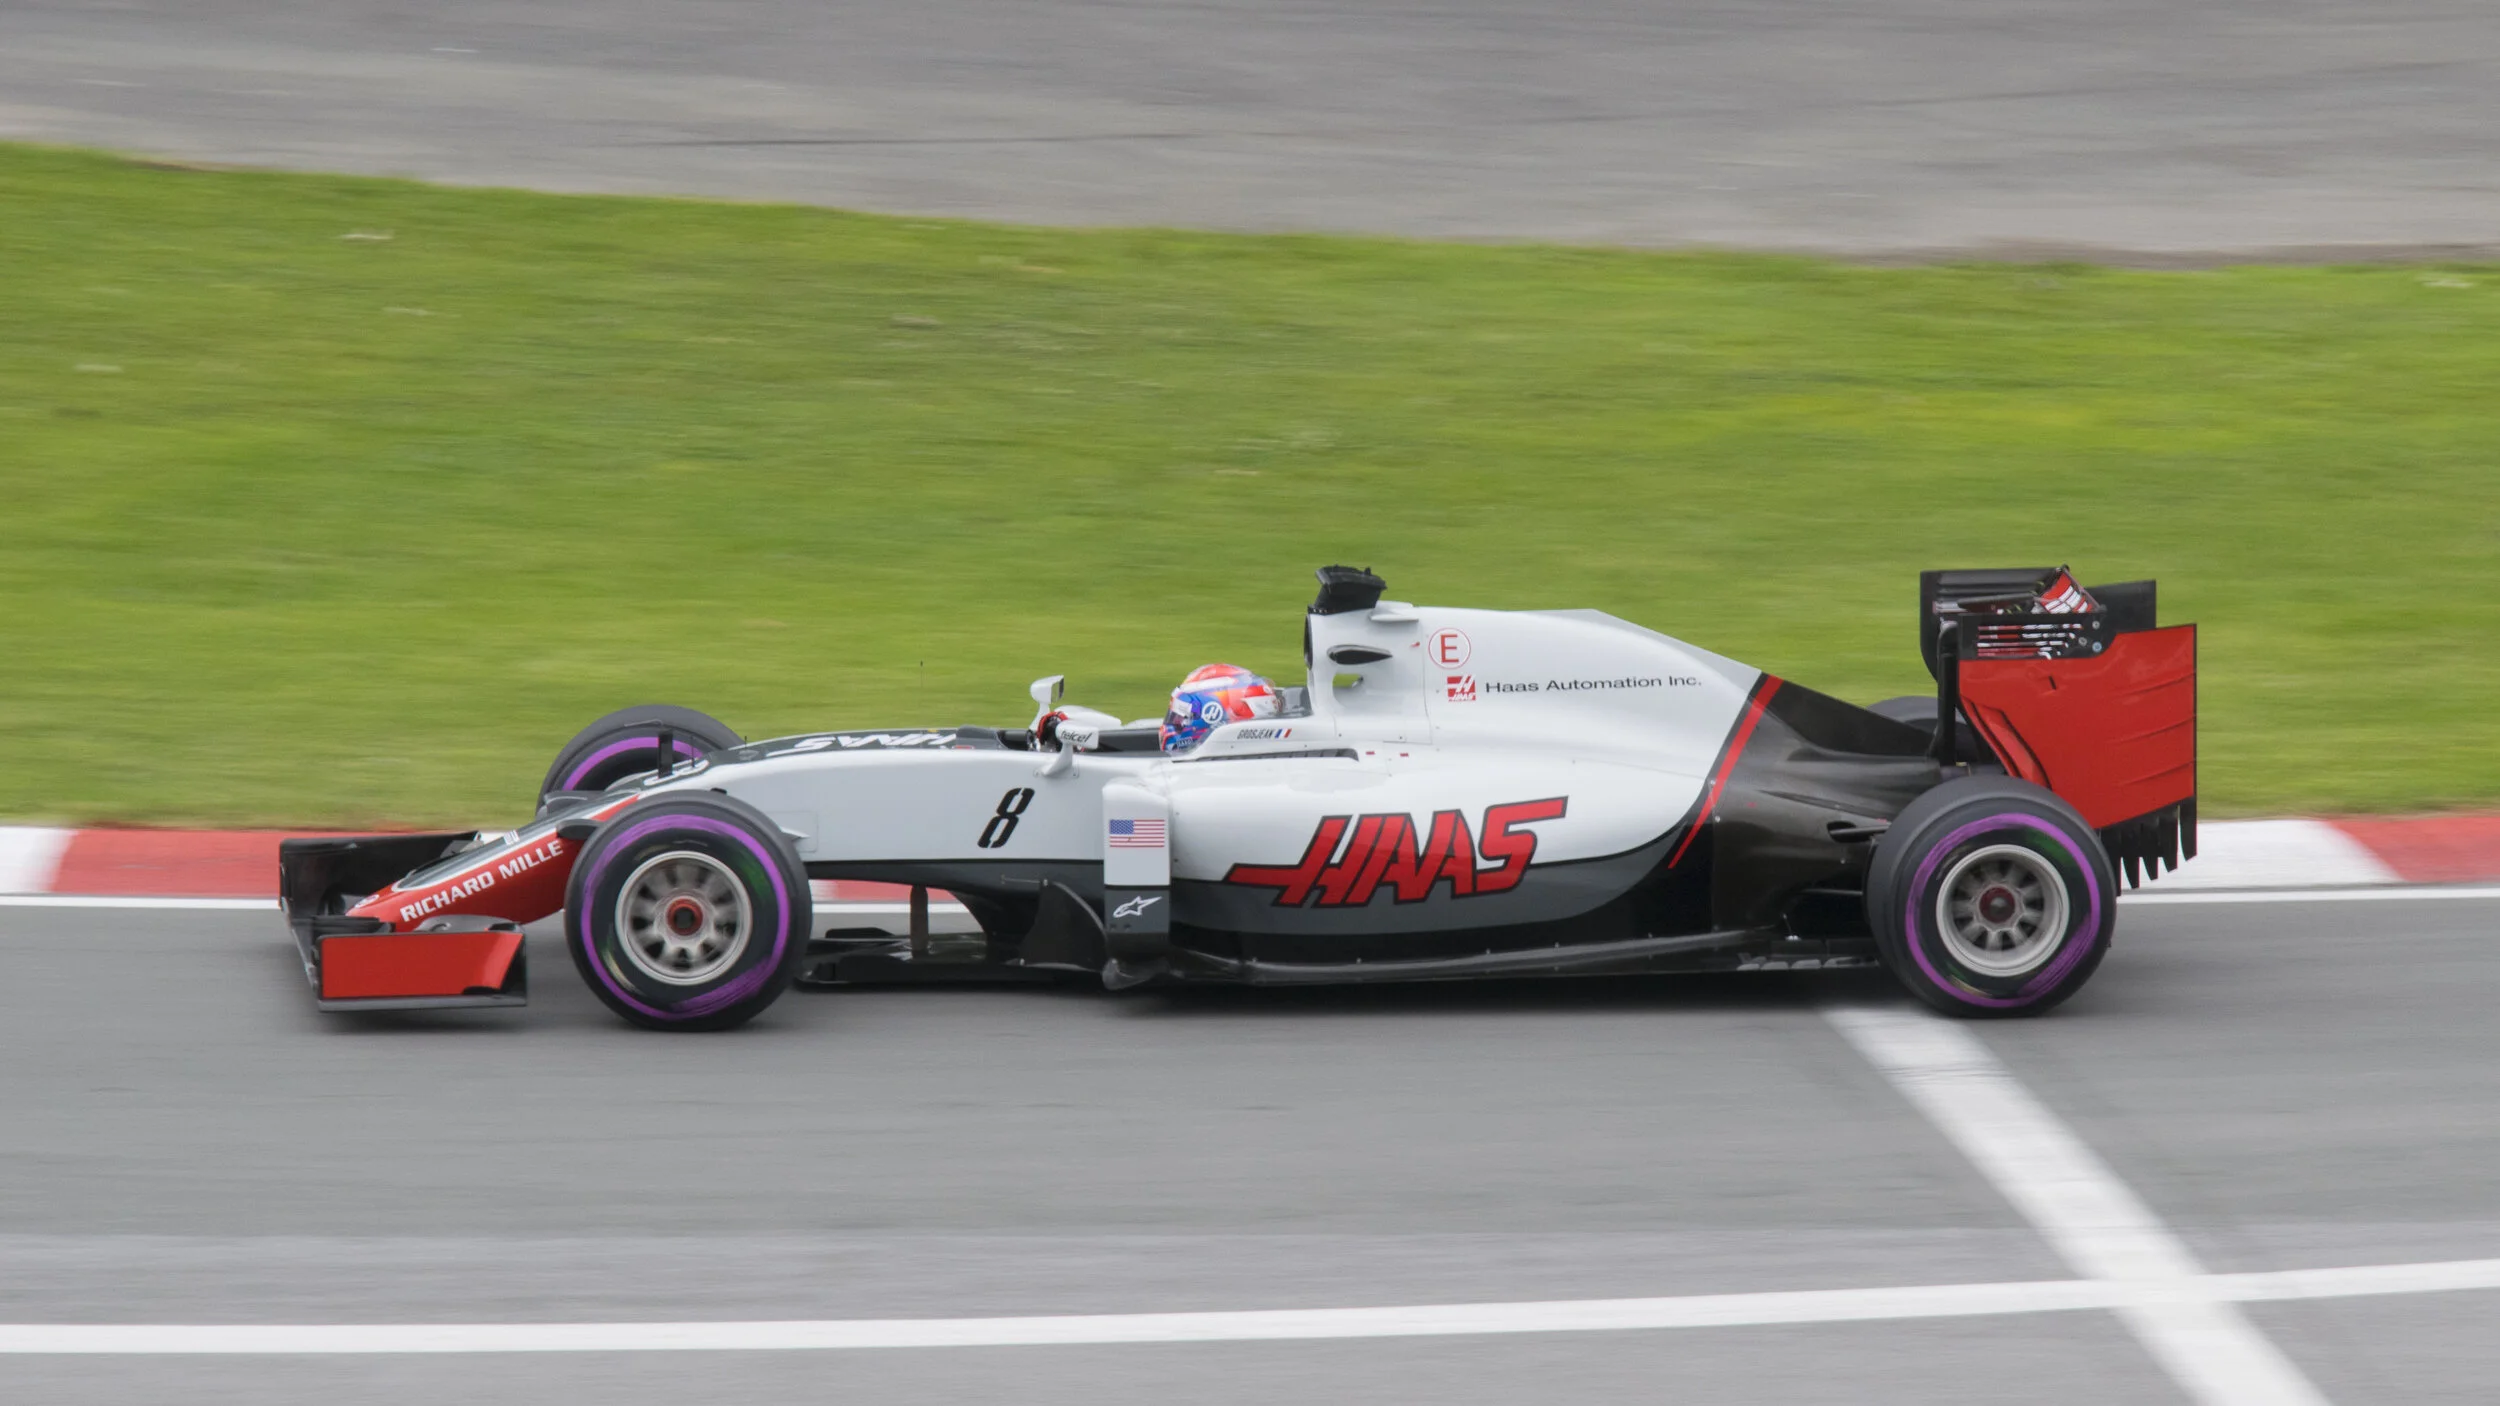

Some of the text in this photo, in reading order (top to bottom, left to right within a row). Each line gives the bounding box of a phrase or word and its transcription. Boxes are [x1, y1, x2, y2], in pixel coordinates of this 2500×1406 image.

[1440, 633, 1460, 663] E
[1485, 675, 1702, 693] Haas Automation Inc.
[1061, 729, 1093, 743] telcel
[1236, 728, 1275, 740] GROSJEAN
[977, 787, 1035, 848] 8
[1223, 795, 1569, 908] HAAS
[400, 839, 564, 922] RICHARD MILLE
